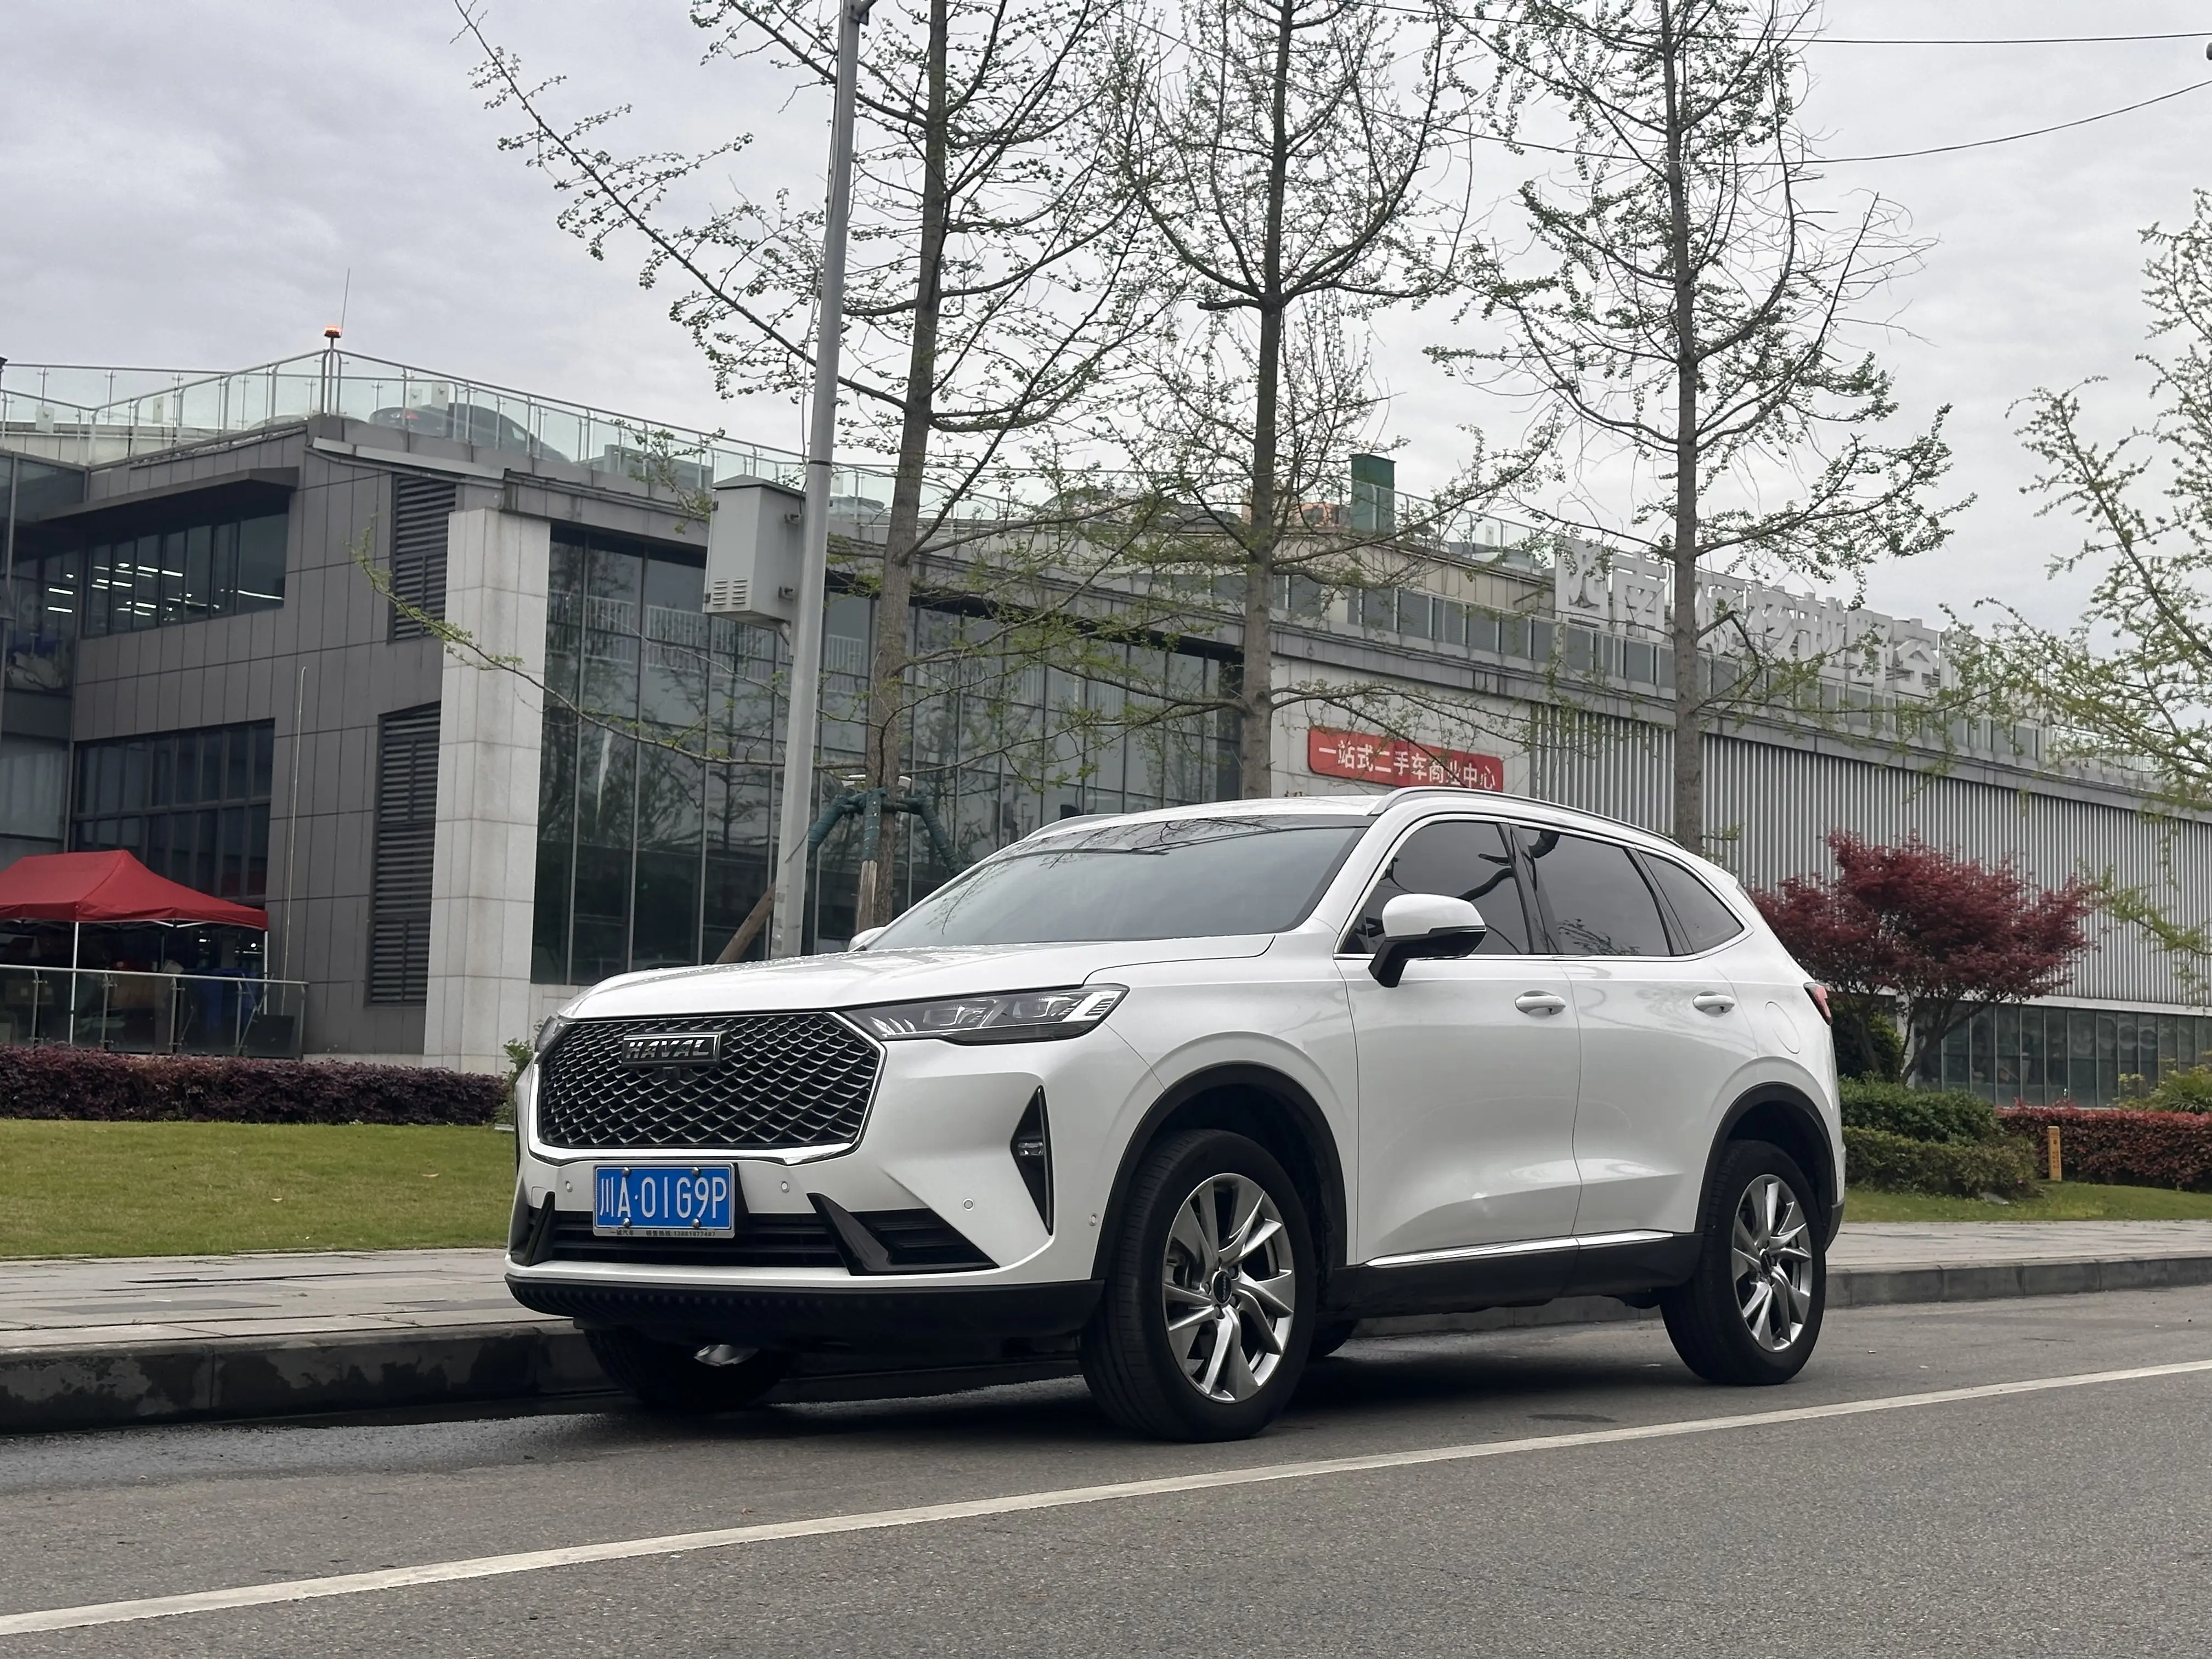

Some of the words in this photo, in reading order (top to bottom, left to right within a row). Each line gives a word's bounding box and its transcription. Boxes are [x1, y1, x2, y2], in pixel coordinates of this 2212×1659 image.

[1319, 740, 1496, 790] 一站式二手车商业中心
[626, 1039, 709, 1059] HAVAL
